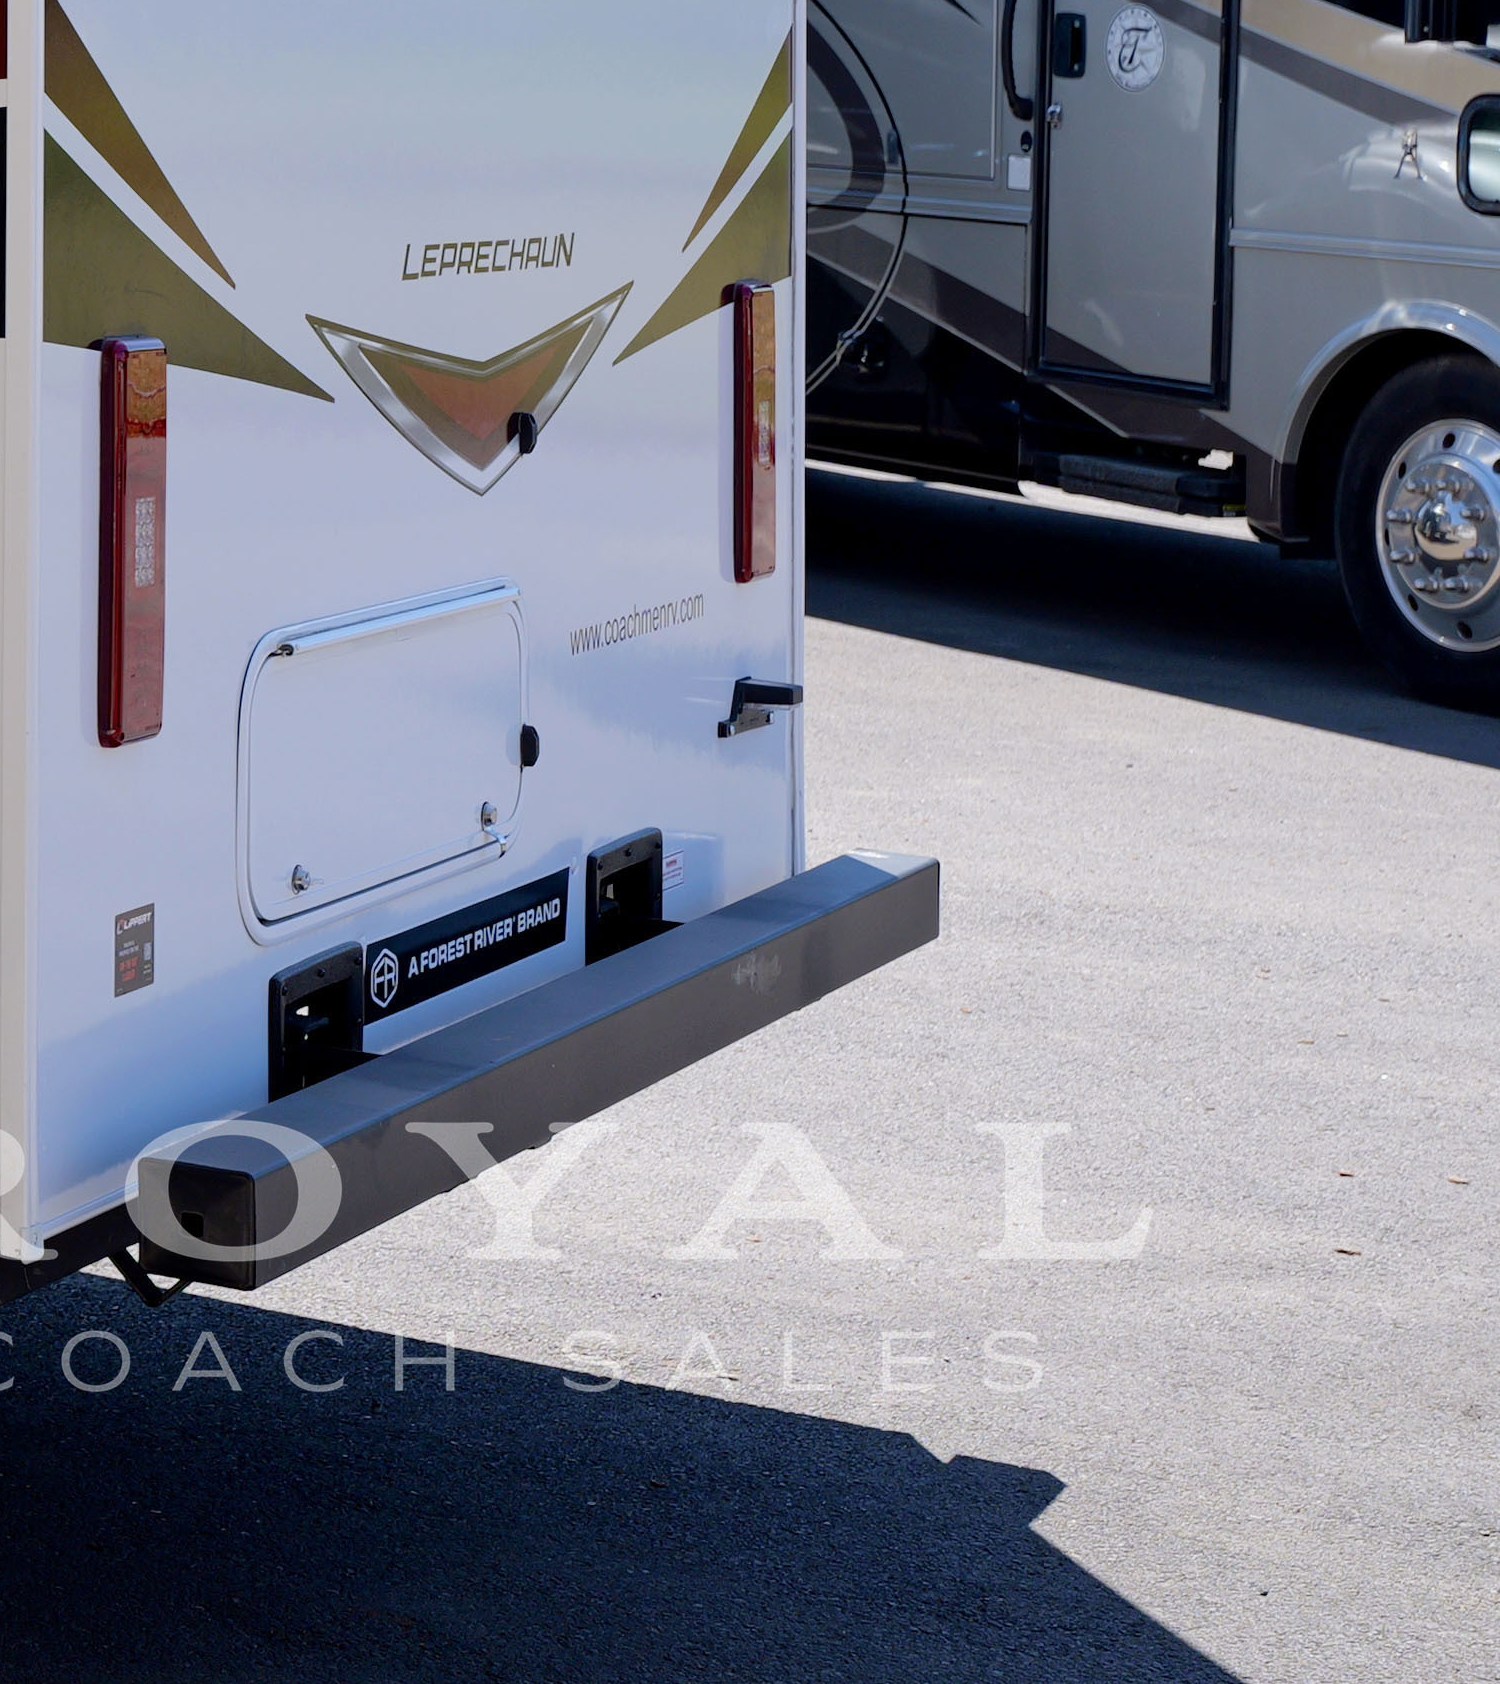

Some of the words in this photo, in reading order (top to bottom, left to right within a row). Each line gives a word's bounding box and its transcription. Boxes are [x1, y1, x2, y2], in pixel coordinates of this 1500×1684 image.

[401, 233, 575, 281] LEPRECHAUN
[570, 593, 705, 657] www.coachmenrv.com
[408, 956, 419, 978] A
[420, 933, 473, 973] FOREST
[517, 898, 561, 933] BRAND
